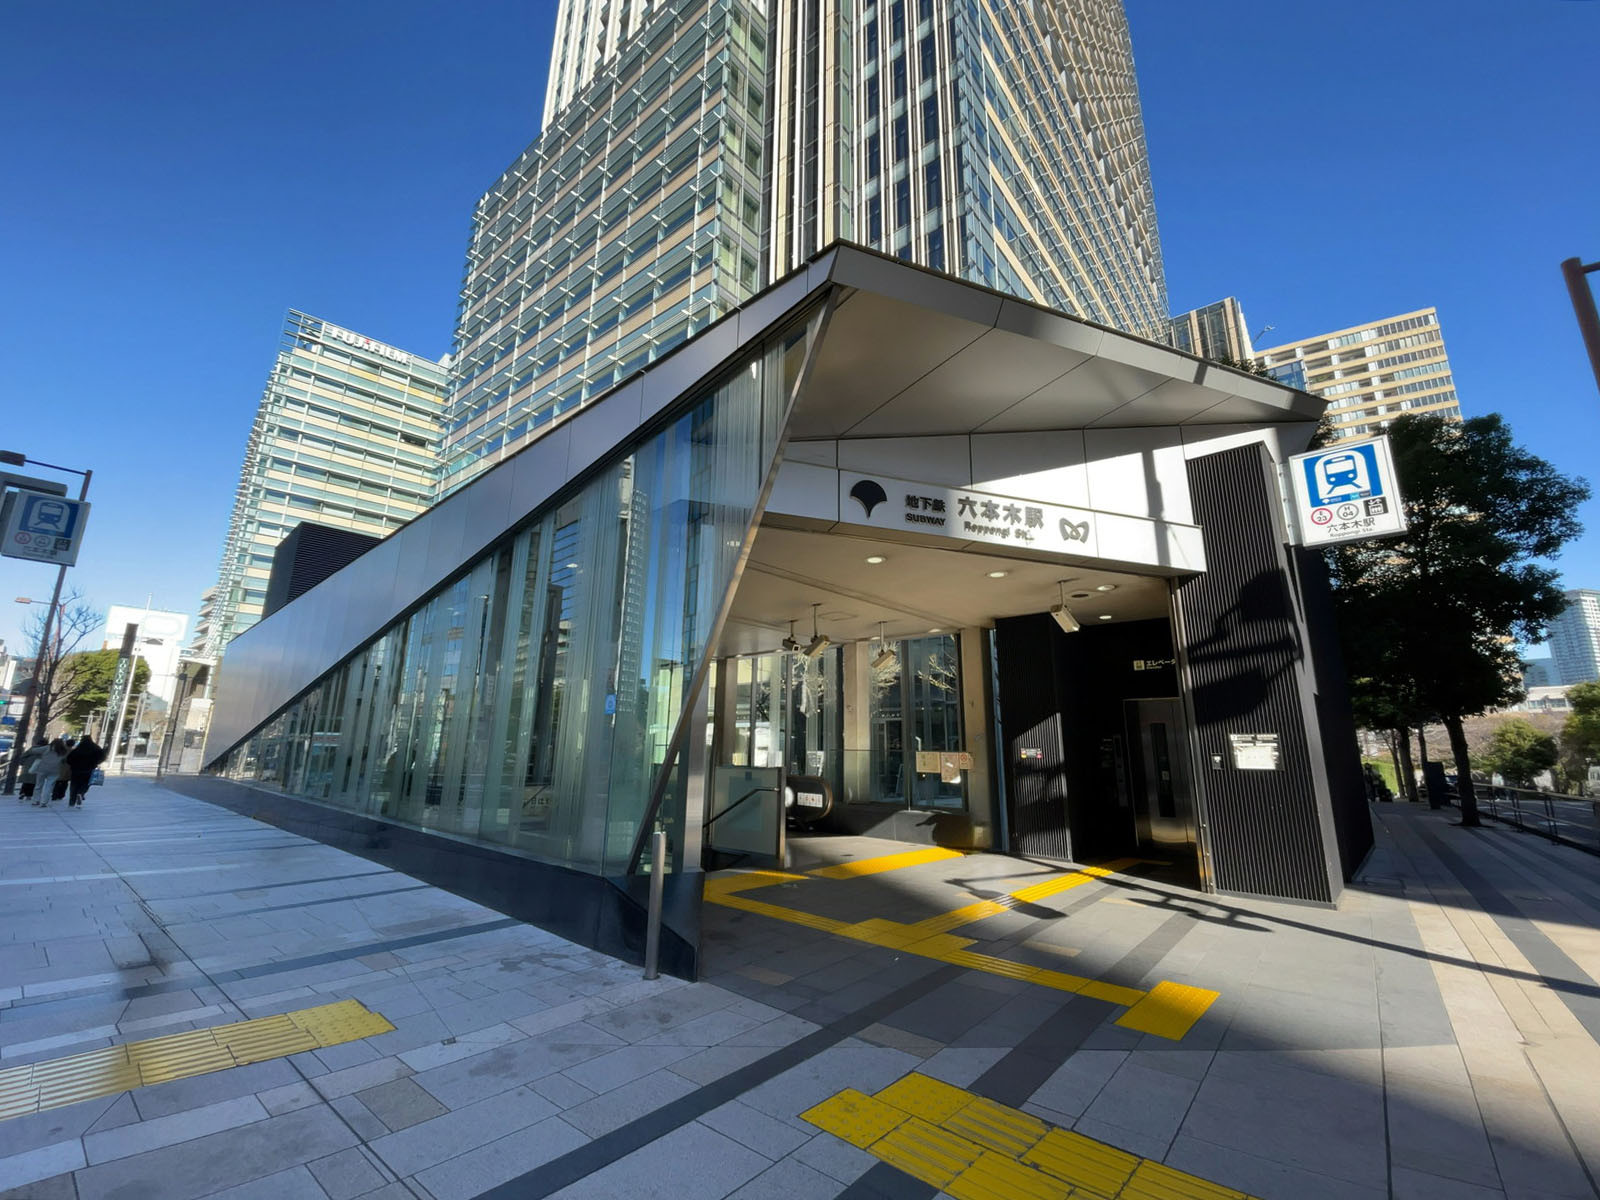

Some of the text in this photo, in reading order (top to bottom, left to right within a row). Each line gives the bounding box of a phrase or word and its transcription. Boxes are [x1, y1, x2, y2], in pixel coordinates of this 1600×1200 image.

[905, 495, 946, 513] 地下鉄
[958, 496, 1044, 529] 六本木駅
[905, 513, 946, 526] SUBWAY
[1327, 517, 1375, 533] 六本木駅
[116, 658, 128, 684] TOKYO
